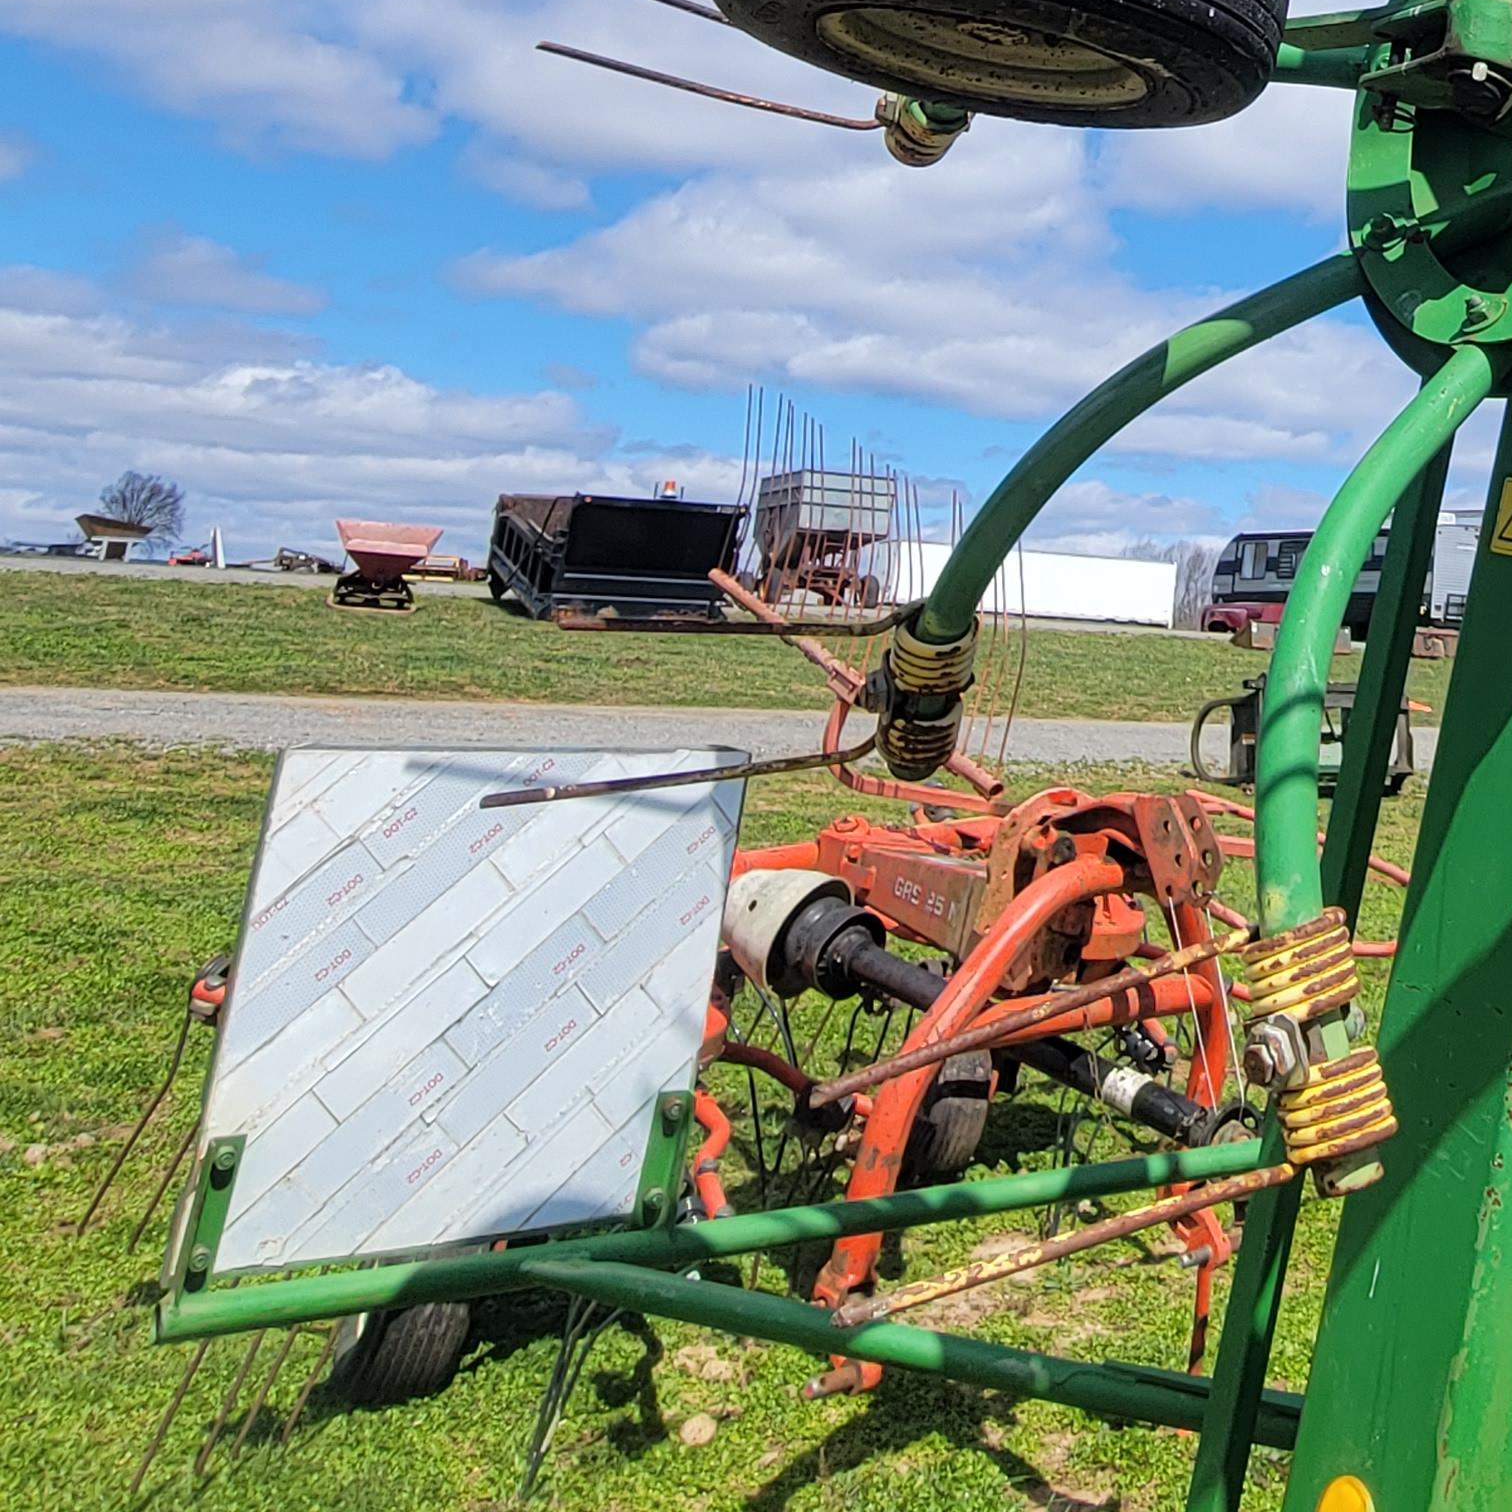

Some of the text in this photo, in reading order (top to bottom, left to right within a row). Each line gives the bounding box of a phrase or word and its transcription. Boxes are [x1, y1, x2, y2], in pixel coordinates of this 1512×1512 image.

[523, 758, 556, 787] DOT-C2
[383, 807, 418, 839] DOT-C2
[469, 823, 503, 854] DOT-C2
[686, 826, 716, 855] DOT-C2
[325, 873, 364, 906] DOT-C2
[679, 895, 710, 926] DOT-C2
[314, 948, 352, 982] DOT-C2
[553, 943, 586, 975] DOT-C2
[544, 1019, 577, 1052] DOT-C2
[407, 1072, 444, 1106] DOT-C2
[407, 1148, 443, 1184] DOT-C2
